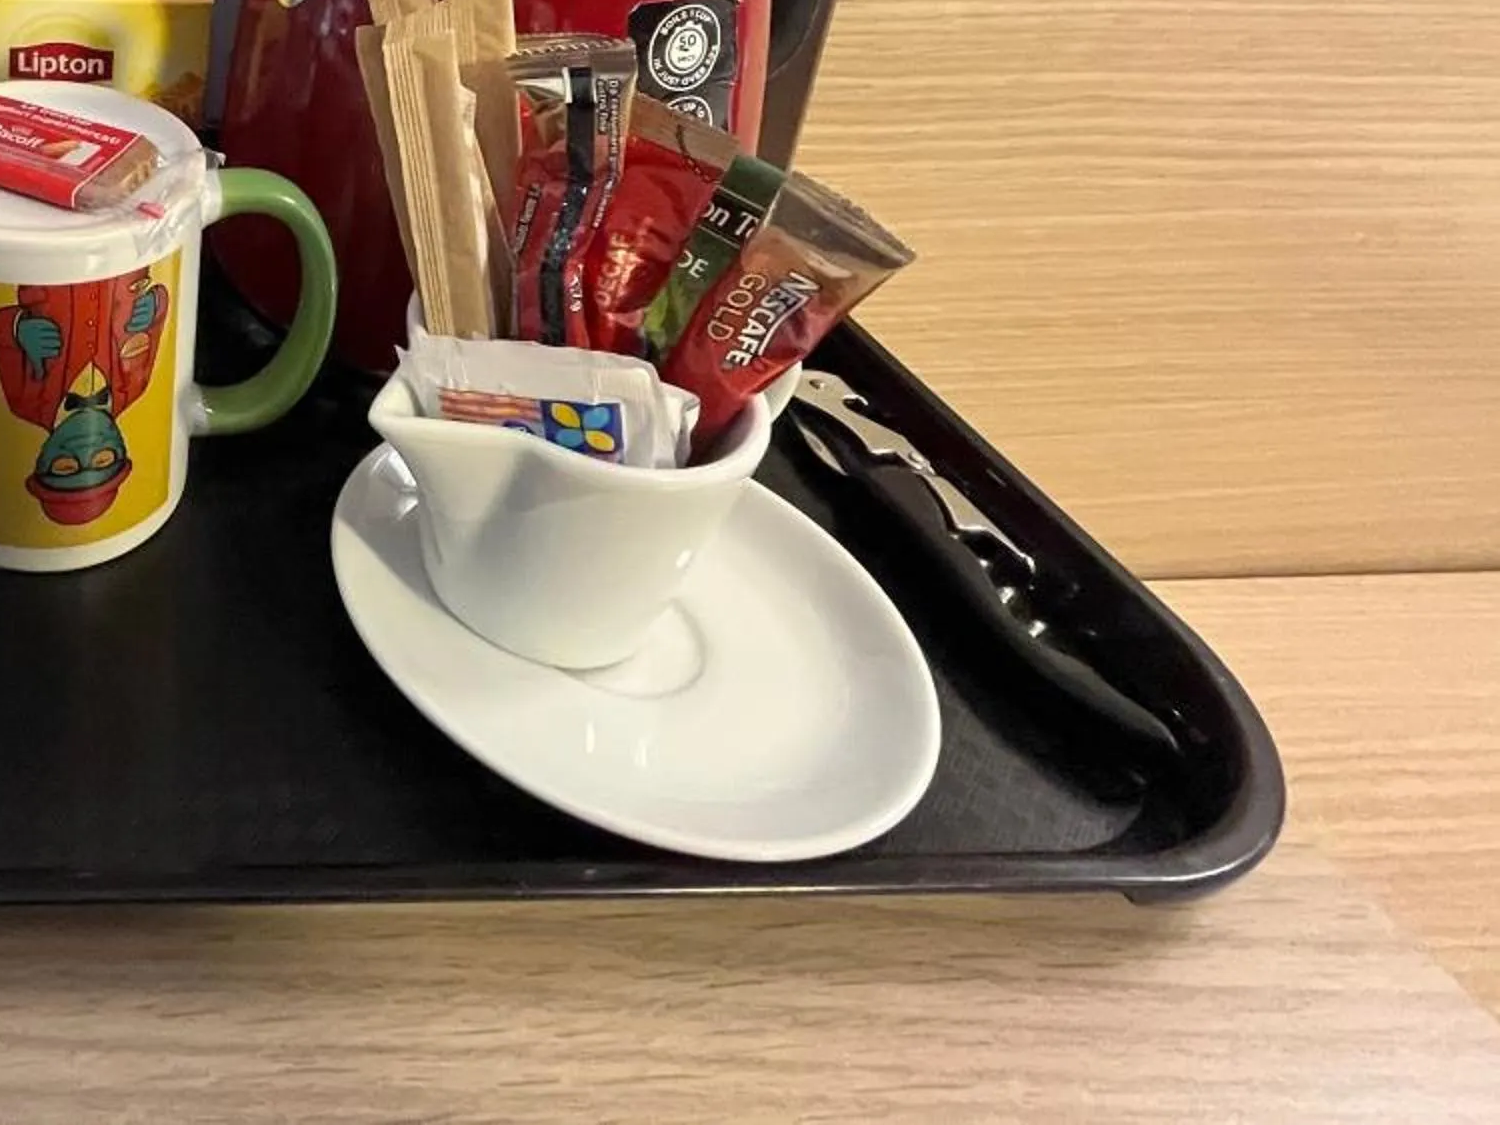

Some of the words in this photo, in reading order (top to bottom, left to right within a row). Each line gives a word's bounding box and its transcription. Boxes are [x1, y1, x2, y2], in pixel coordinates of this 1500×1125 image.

[678, 34, 697, 48] 50
[17, 52, 105, 77] Lipton
[707, 274, 767, 342] GOLD
